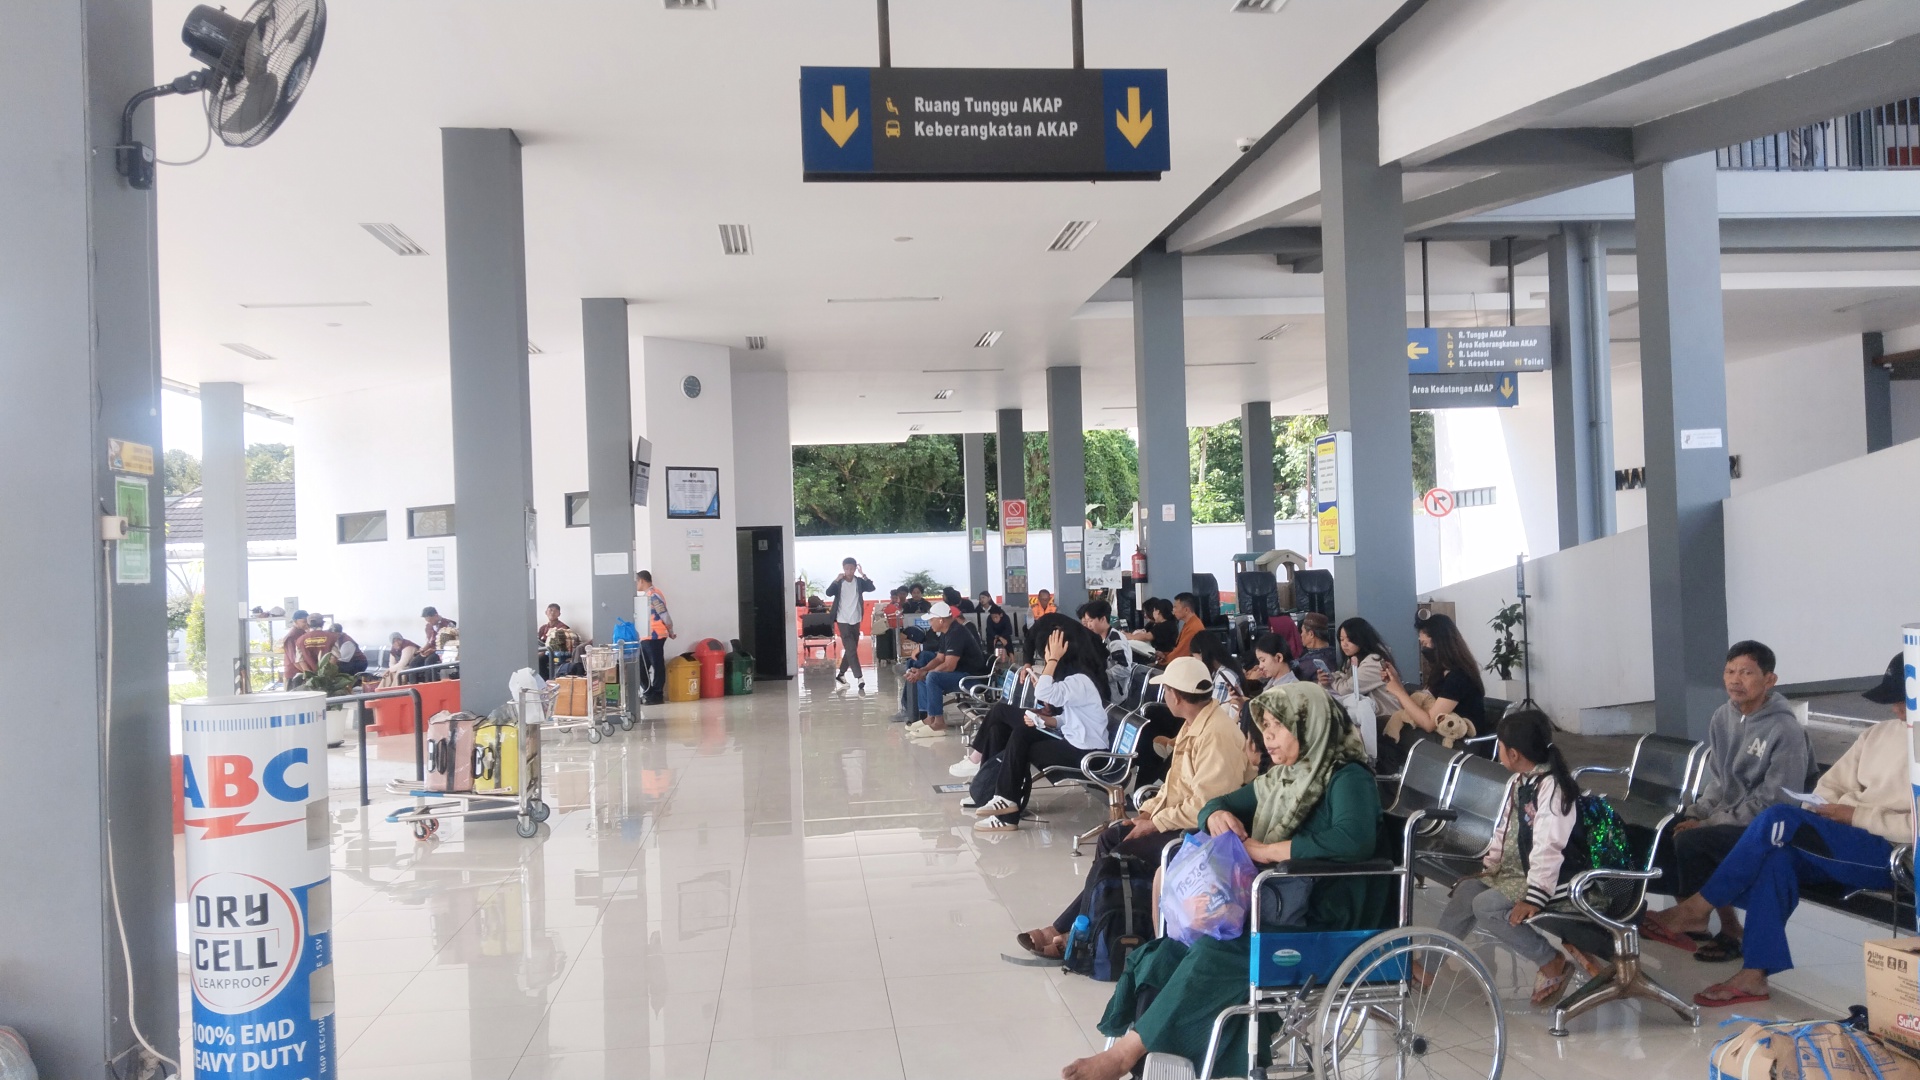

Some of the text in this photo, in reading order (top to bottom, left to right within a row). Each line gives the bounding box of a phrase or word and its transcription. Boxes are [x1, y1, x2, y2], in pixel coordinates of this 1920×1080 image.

[914, 97, 1063, 116] Ruang Tunggu AKAP
[914, 121, 1079, 140] Keberangkatan AKAP
[1458, 330, 1507, 340] R. Tunggu AKAP
[1458, 339, 1538, 349] Area Keberangkatan AKAP
[1458, 350, 1490, 358] R. Laktasi
[1523, 358, 1544, 366] Toilet
[1468, 359, 1505, 367] Kesehatan
[1412, 384, 1494, 395] Area Kedatangan AKAP
[183, 747, 309, 809] ABC
[195, 893, 269, 928] DRY
[195, 937, 278, 971] CELL
[315, 938, 323, 959] 1.5V
[1867, 950, 1873, 963] 2
[199, 976, 270, 989] LEAKPROOF
[1898, 1015, 1920, 1031] SunC
[193, 1019, 294, 1046] 100% EMD
[242, 1041, 307, 1072] DUTY
